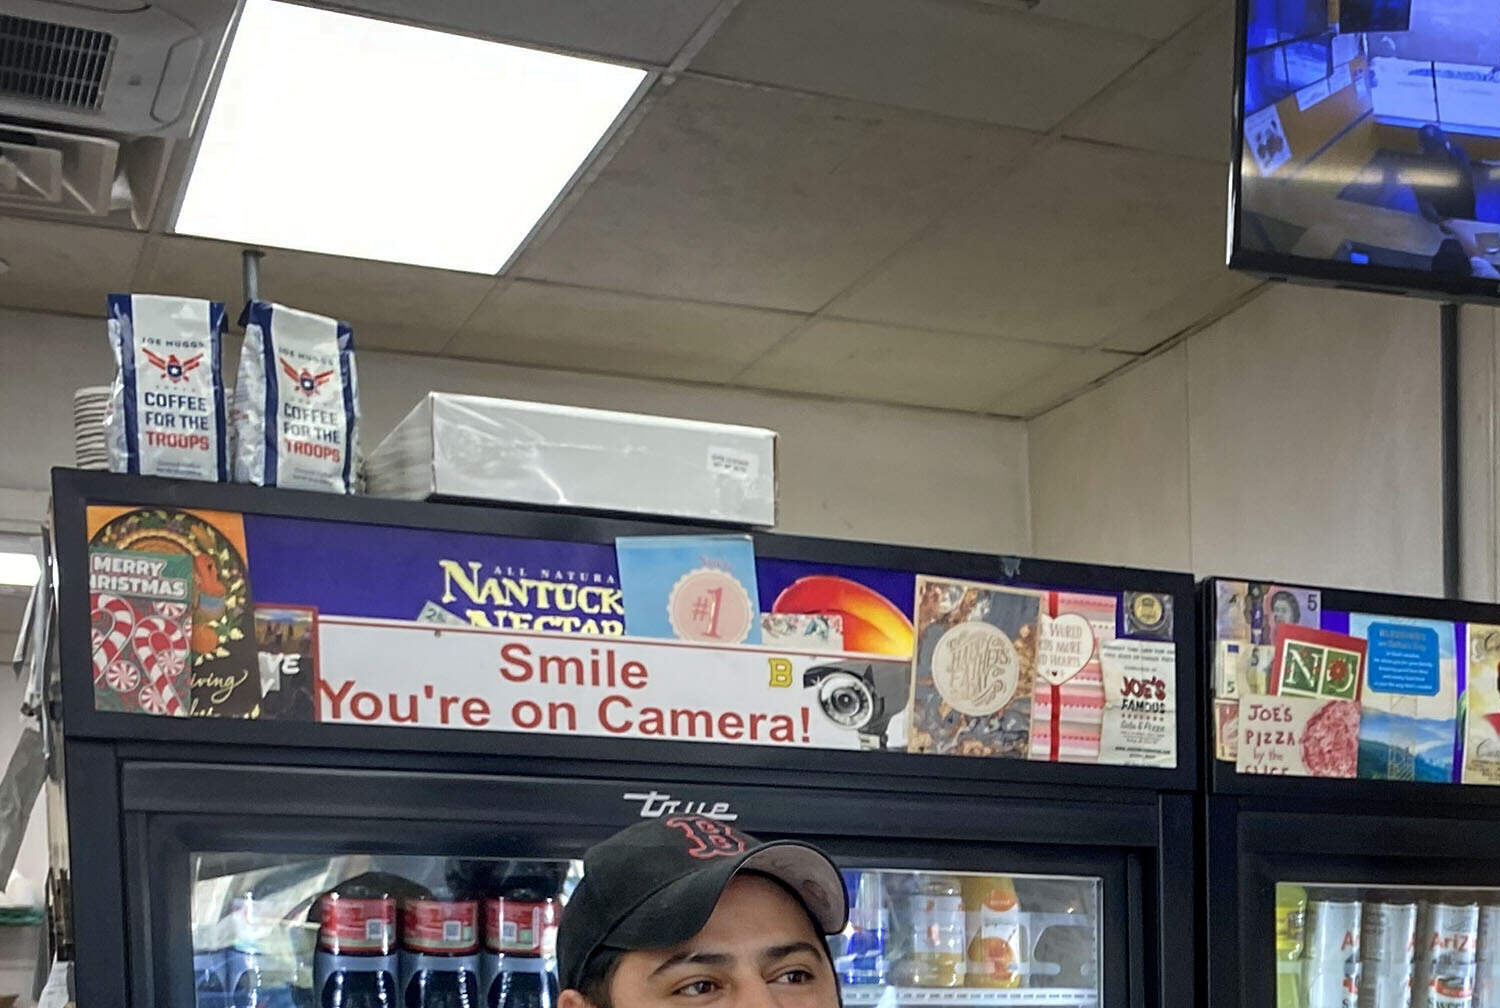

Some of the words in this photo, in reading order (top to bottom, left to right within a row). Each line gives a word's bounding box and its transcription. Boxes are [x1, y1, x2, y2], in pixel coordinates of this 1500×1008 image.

[144, 392, 207, 411] COFFEE
[146, 411, 175, 427] FOR
[179, 415, 208, 430] THE
[284, 402, 338, 425] COFFEE
[146, 431, 209, 450] TROOPS
[284, 422, 311, 438] FOR
[313, 427, 341, 444] THE
[285, 440, 341, 463] TROOPS
[94, 556, 164, 578] MERRY
[494, 566, 528, 577] ALL
[692, 587, 722, 638] #1
[1307, 594, 1318, 612] 5
[500, 643, 649, 689] Smile
[768, 658, 793, 688] B
[1120, 676, 1167, 701] JOE'S
[318, 679, 491, 726] You're
[511, 700, 578, 731] on
[599, 695, 810, 744] Camera!
[1121, 698, 1167, 714] FAMOUS
[1248, 704, 1293, 723] JOE'S
[1246, 730, 1296, 747] PIZZA
[1253, 751, 1265, 764] by
[1269, 750, 1284, 762] the
[623, 791, 738, 821] True
[666, 814, 745, 859] B
